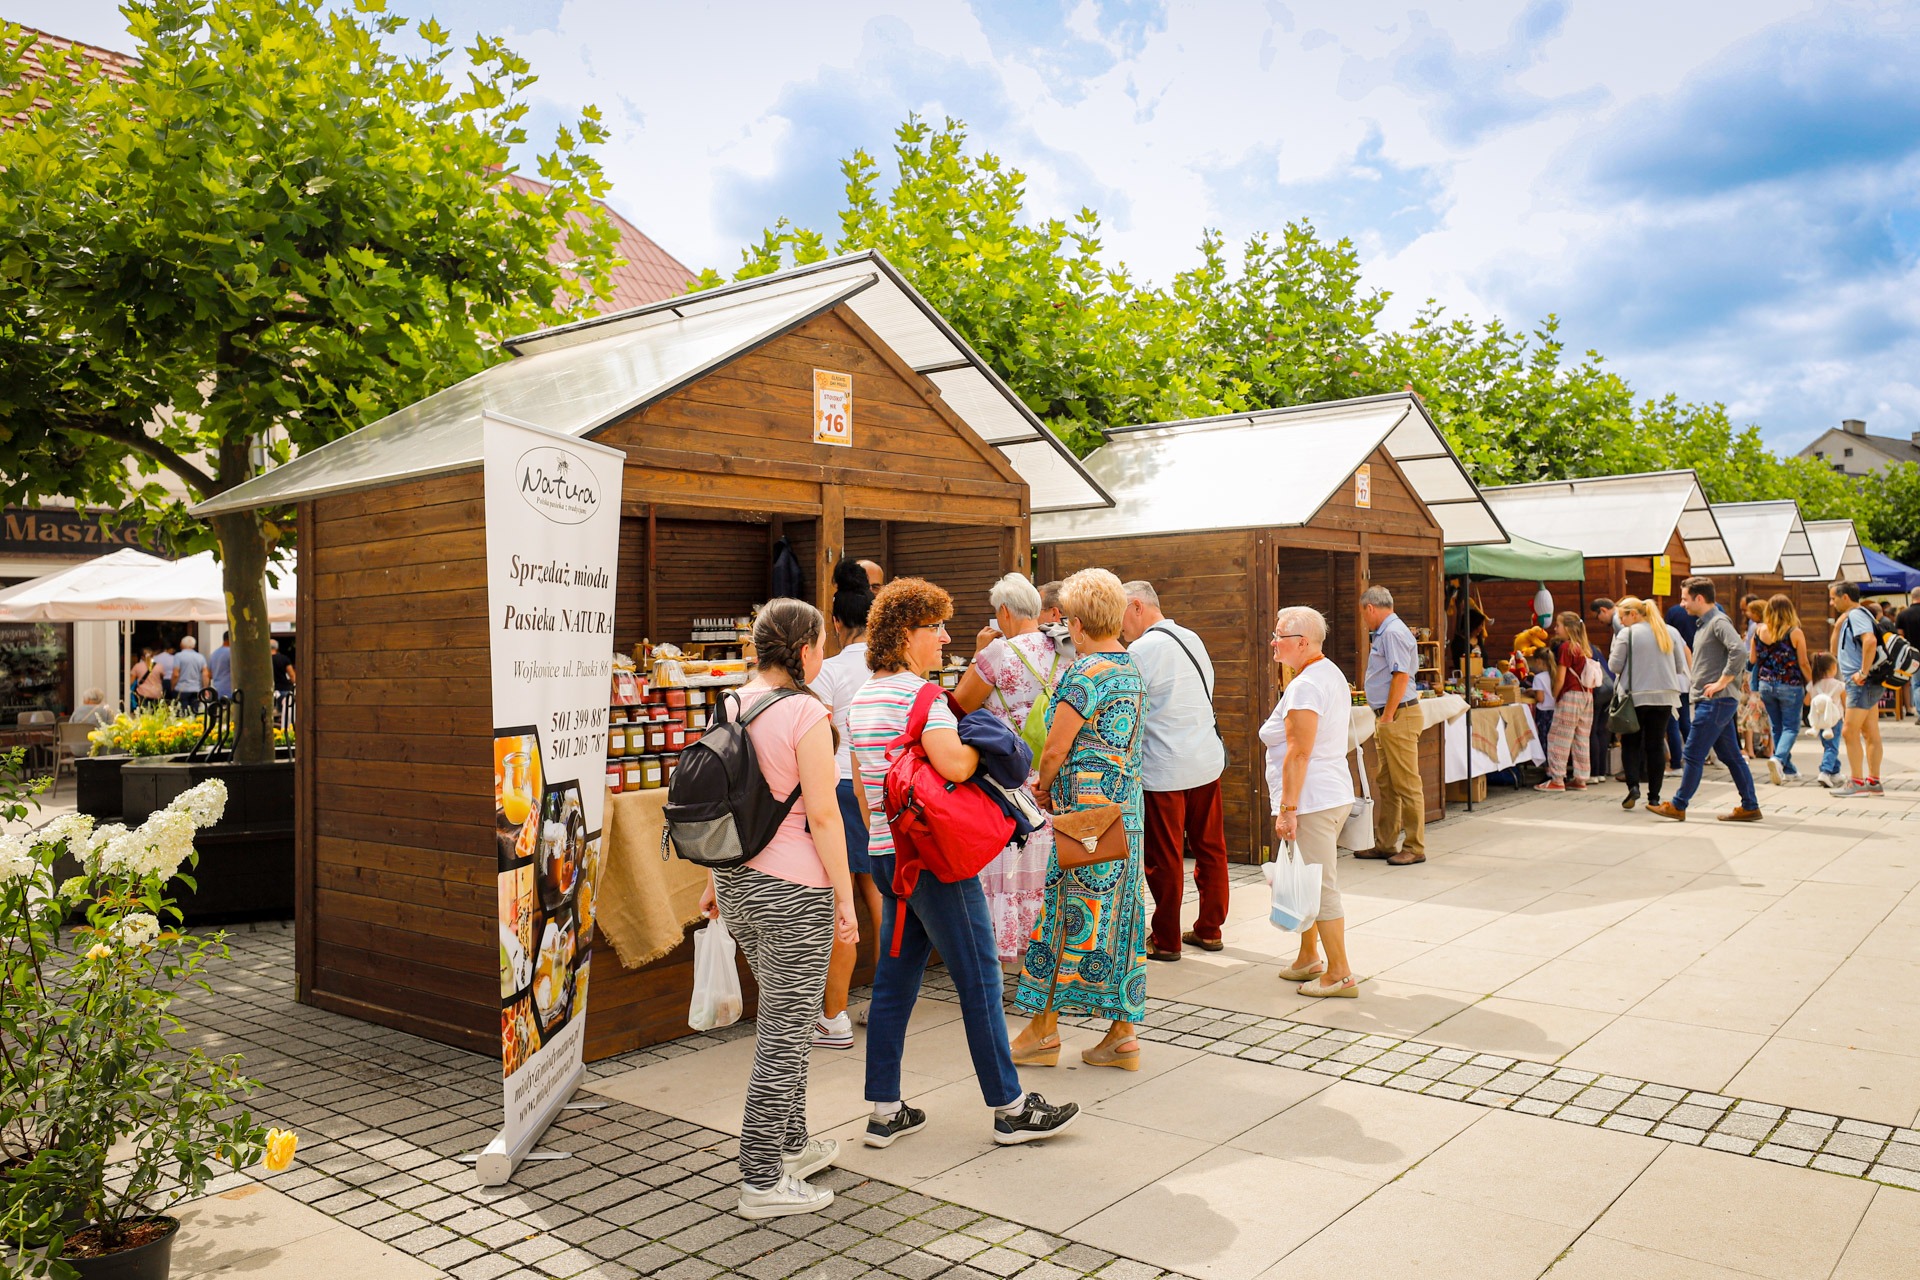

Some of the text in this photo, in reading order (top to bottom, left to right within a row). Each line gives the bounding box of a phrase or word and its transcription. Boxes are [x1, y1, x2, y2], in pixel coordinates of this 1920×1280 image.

[825, 413, 844, 433] 16
[522, 466, 597, 504] Natura
[1360, 488, 1367, 500] 17
[5, 514, 167, 553] Maszke
[510, 554, 609, 589] Sprzedaż miodu
[503, 605, 613, 634] Pasieka NATURA
[514, 660, 609, 683] Wojkowice ul. Piaski 86
[551, 708, 607, 732] 501 399 887
[551, 739, 571, 760] 501
[573, 736, 588, 756] 203
[591, 733, 605, 754] 787
